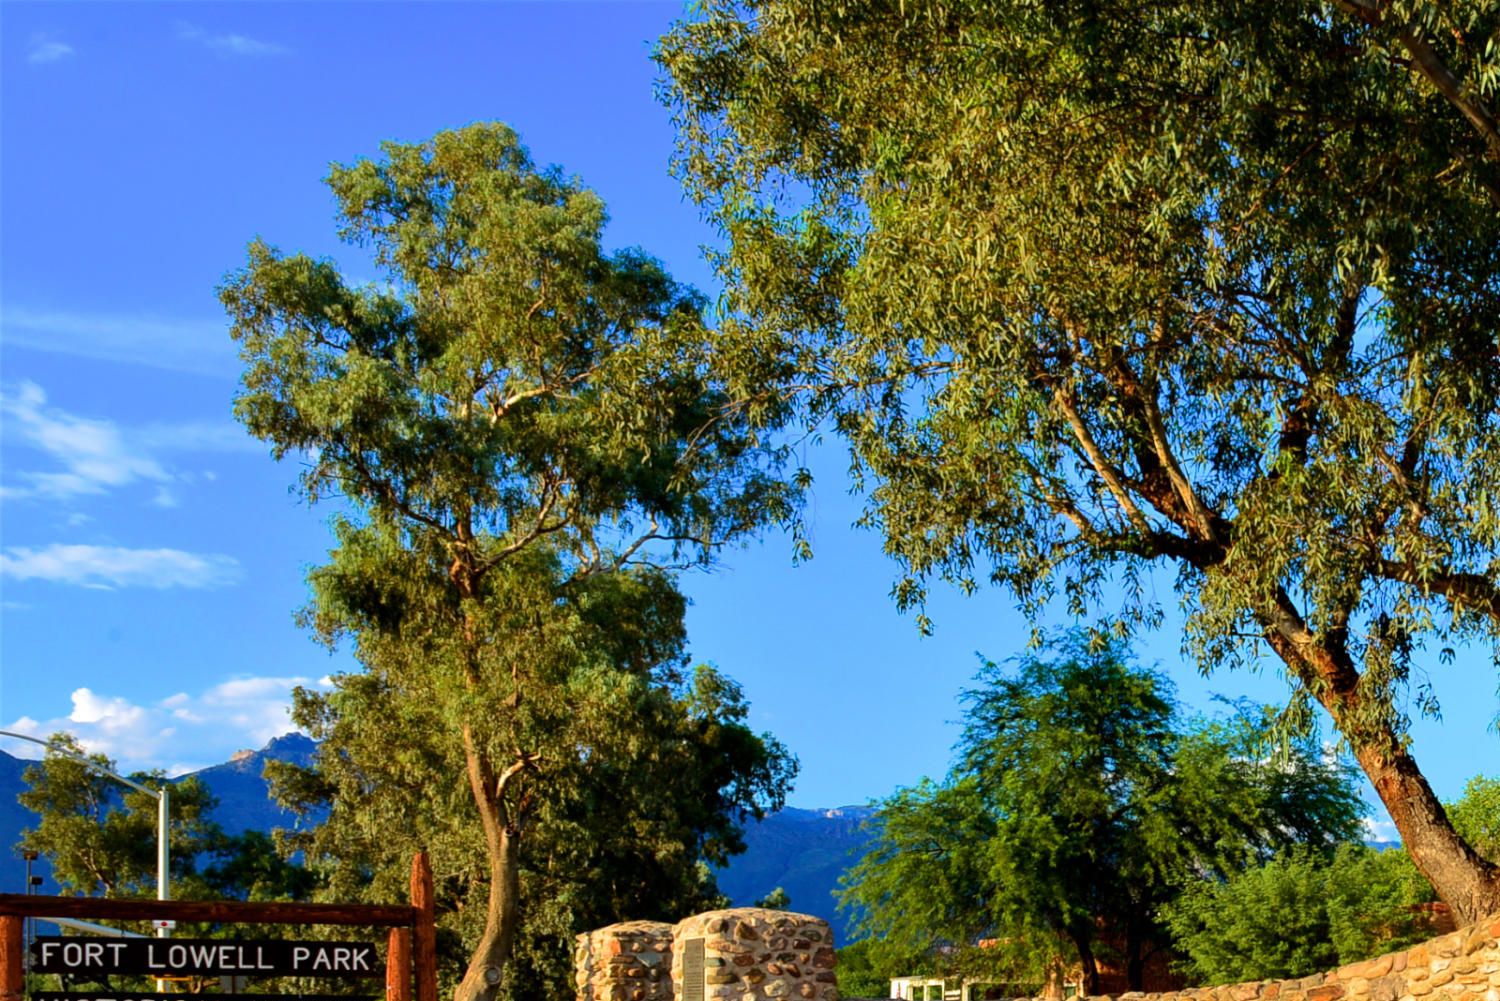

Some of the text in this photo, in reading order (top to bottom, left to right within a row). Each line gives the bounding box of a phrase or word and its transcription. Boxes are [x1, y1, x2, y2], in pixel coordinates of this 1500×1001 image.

[41, 942, 370, 971] FORT LOWELL PARK
